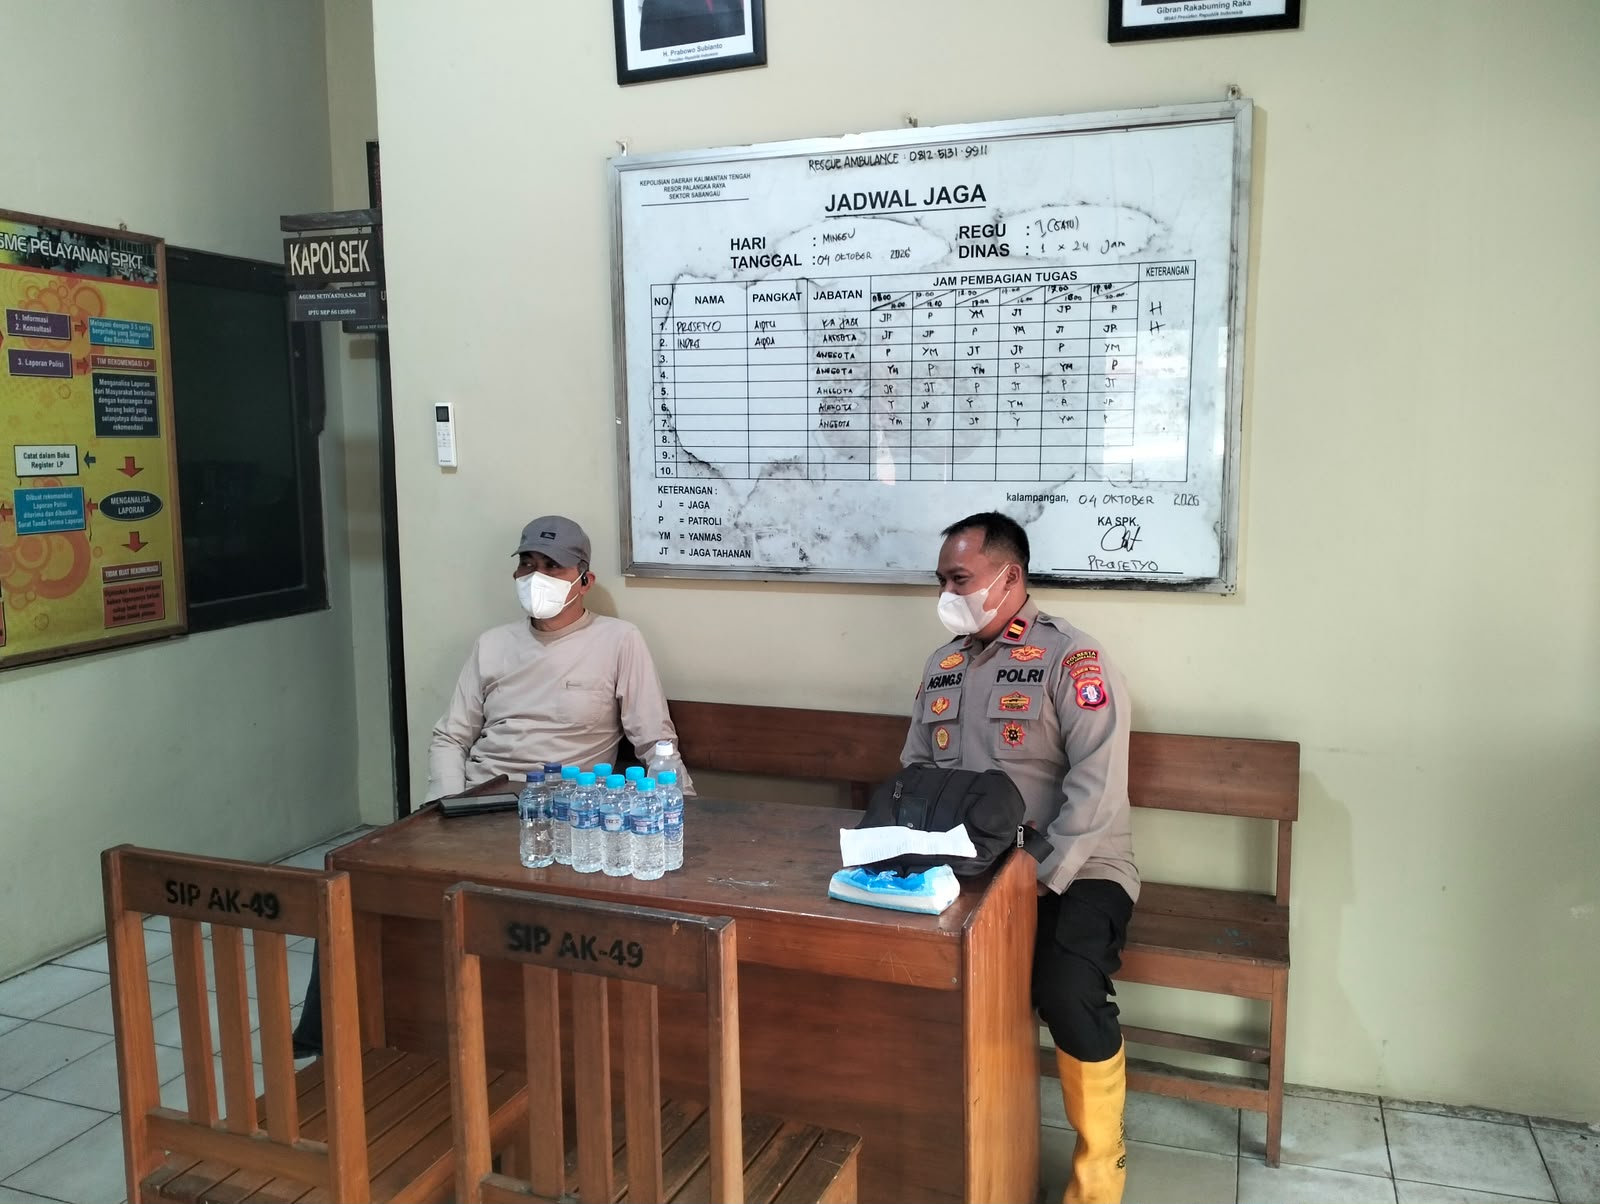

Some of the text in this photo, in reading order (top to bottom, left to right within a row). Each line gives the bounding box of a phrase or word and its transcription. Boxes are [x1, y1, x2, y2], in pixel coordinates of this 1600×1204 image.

[1157, 0, 1252, 14] Gibran Rakabuming Raka
[670, 48, 695, 56] Prabowo
[696, 44, 722, 52] Subianto
[844, 152, 899, 168] AMBULANCE
[640, 178, 670, 186] KEPOLISIAN
[694, 175, 728, 183] KALIMANTAN
[682, 184, 711, 192] PALANGKA
[692, 190, 720, 198] SABANGAU
[825, 184, 986, 212] JADWAL JAGA
[959, 223, 1006, 239] REGU
[730, 237, 766, 250] HARI
[31, 238, 108, 265] PELAYANAN
[112, 252, 144, 270] SPKT
[958, 243, 1010, 258] DINAS
[1072, 242, 1089, 252] 24
[290, 240, 370, 276] KAPOLSEK
[730, 254, 802, 268] TANGGAL
[1146, 266, 1190, 276] KETERANGAN
[933, 271, 1078, 286] JAM PEMBAGIAN TUGAS
[694, 290, 862, 304] NAMA PANGKAT JABATAN
[15, 314, 48, 324] 1. Informasi
[16, 324, 51, 334] 2. Konsultasi
[967, 346, 980, 356] JT
[18, 358, 64, 368] 3. Laporan Polisi
[660, 355, 668, 363] 3.
[660, 372, 668, 380] 4.
[661, 388, 668, 396] 5.
[662, 420, 670, 428] 7.
[662, 436, 670, 444] 8.
[24, 452, 38, 460] Catat
[31, 462, 54, 470] Register
[660, 467, 674, 476] 10.
[658, 486, 713, 495] KETERANGAN
[110, 496, 150, 505] MENGANALISA
[1006, 492, 1068, 504] kalampangan,
[1102, 494, 1154, 506] OKTOBER
[658, 500, 710, 510] J JAGA
[118, 506, 144, 515] LAPORAN
[658, 516, 722, 526] P PATROLI
[1098, 516, 1112, 526] KA
[658, 532, 722, 542] YM YANMAS
[659, 547, 751, 558] JT JAGA TAHANAN
[996, 669, 1044, 683] POLRI
[165, 879, 280, 920] SIP AK-49
[507, 920, 644, 968] SIP AK-49
